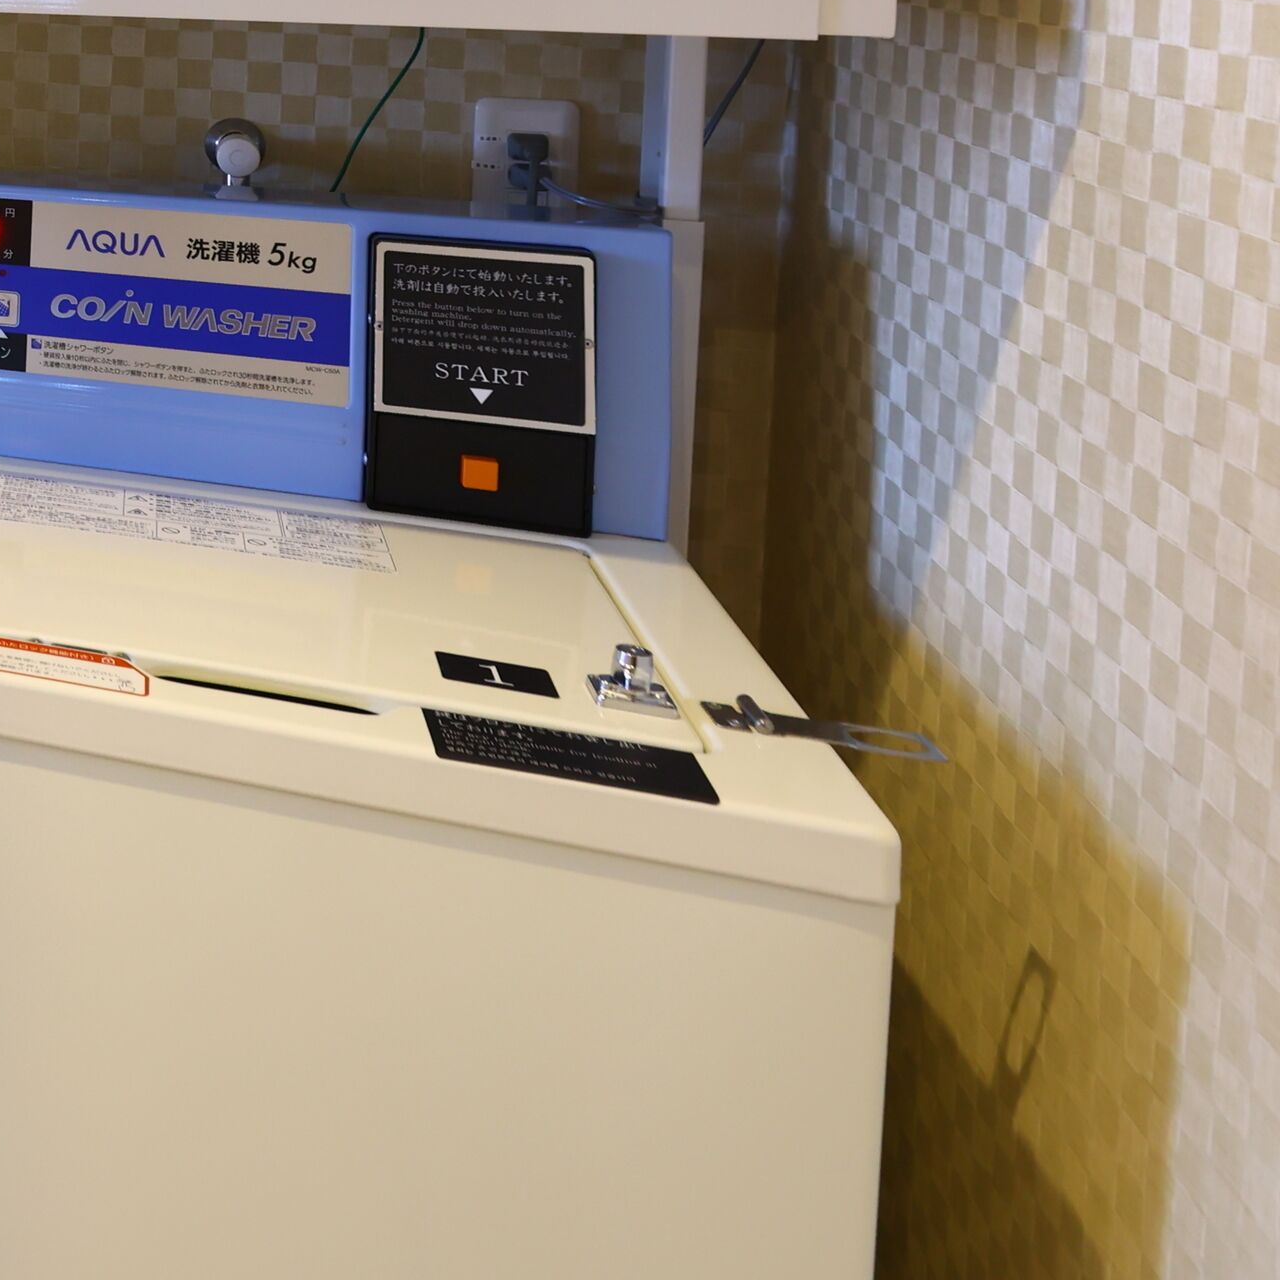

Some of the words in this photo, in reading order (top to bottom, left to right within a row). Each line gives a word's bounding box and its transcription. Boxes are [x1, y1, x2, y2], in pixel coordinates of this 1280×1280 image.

[5, 208, 16, 218] 円
[3, 249, 14, 260] 分
[66, 228, 167, 258] AQUA
[185, 237, 261, 265] 洗濯機
[267, 241, 318, 274] 5kg
[393, 263, 573, 288] 下のボタンにて始動いたします。
[392, 278, 564, 305] 洗剤は自動で投入いたします。
[50, 290, 153, 325] COIN
[162, 304, 318, 343] WASHER
[392, 298, 415, 307] Press
[418, 301, 432, 309] the
[434, 303, 464, 312] button
[466, 305, 494, 314] below
[547, 312, 562, 320] the
[392, 308, 428, 317] washing
[432, 311, 471, 321] machine.
[392, 314, 434, 326] Detergent
[437, 319, 454, 327] will
[457, 321, 479, 330] drop
[480, 324, 507, 332] down
[509, 325, 576, 338] automatically.
[44, 341, 113, 355] 洗濯槽シャワーボタン
[435, 362, 529, 387] START
[478, 663, 515, 688] 1
